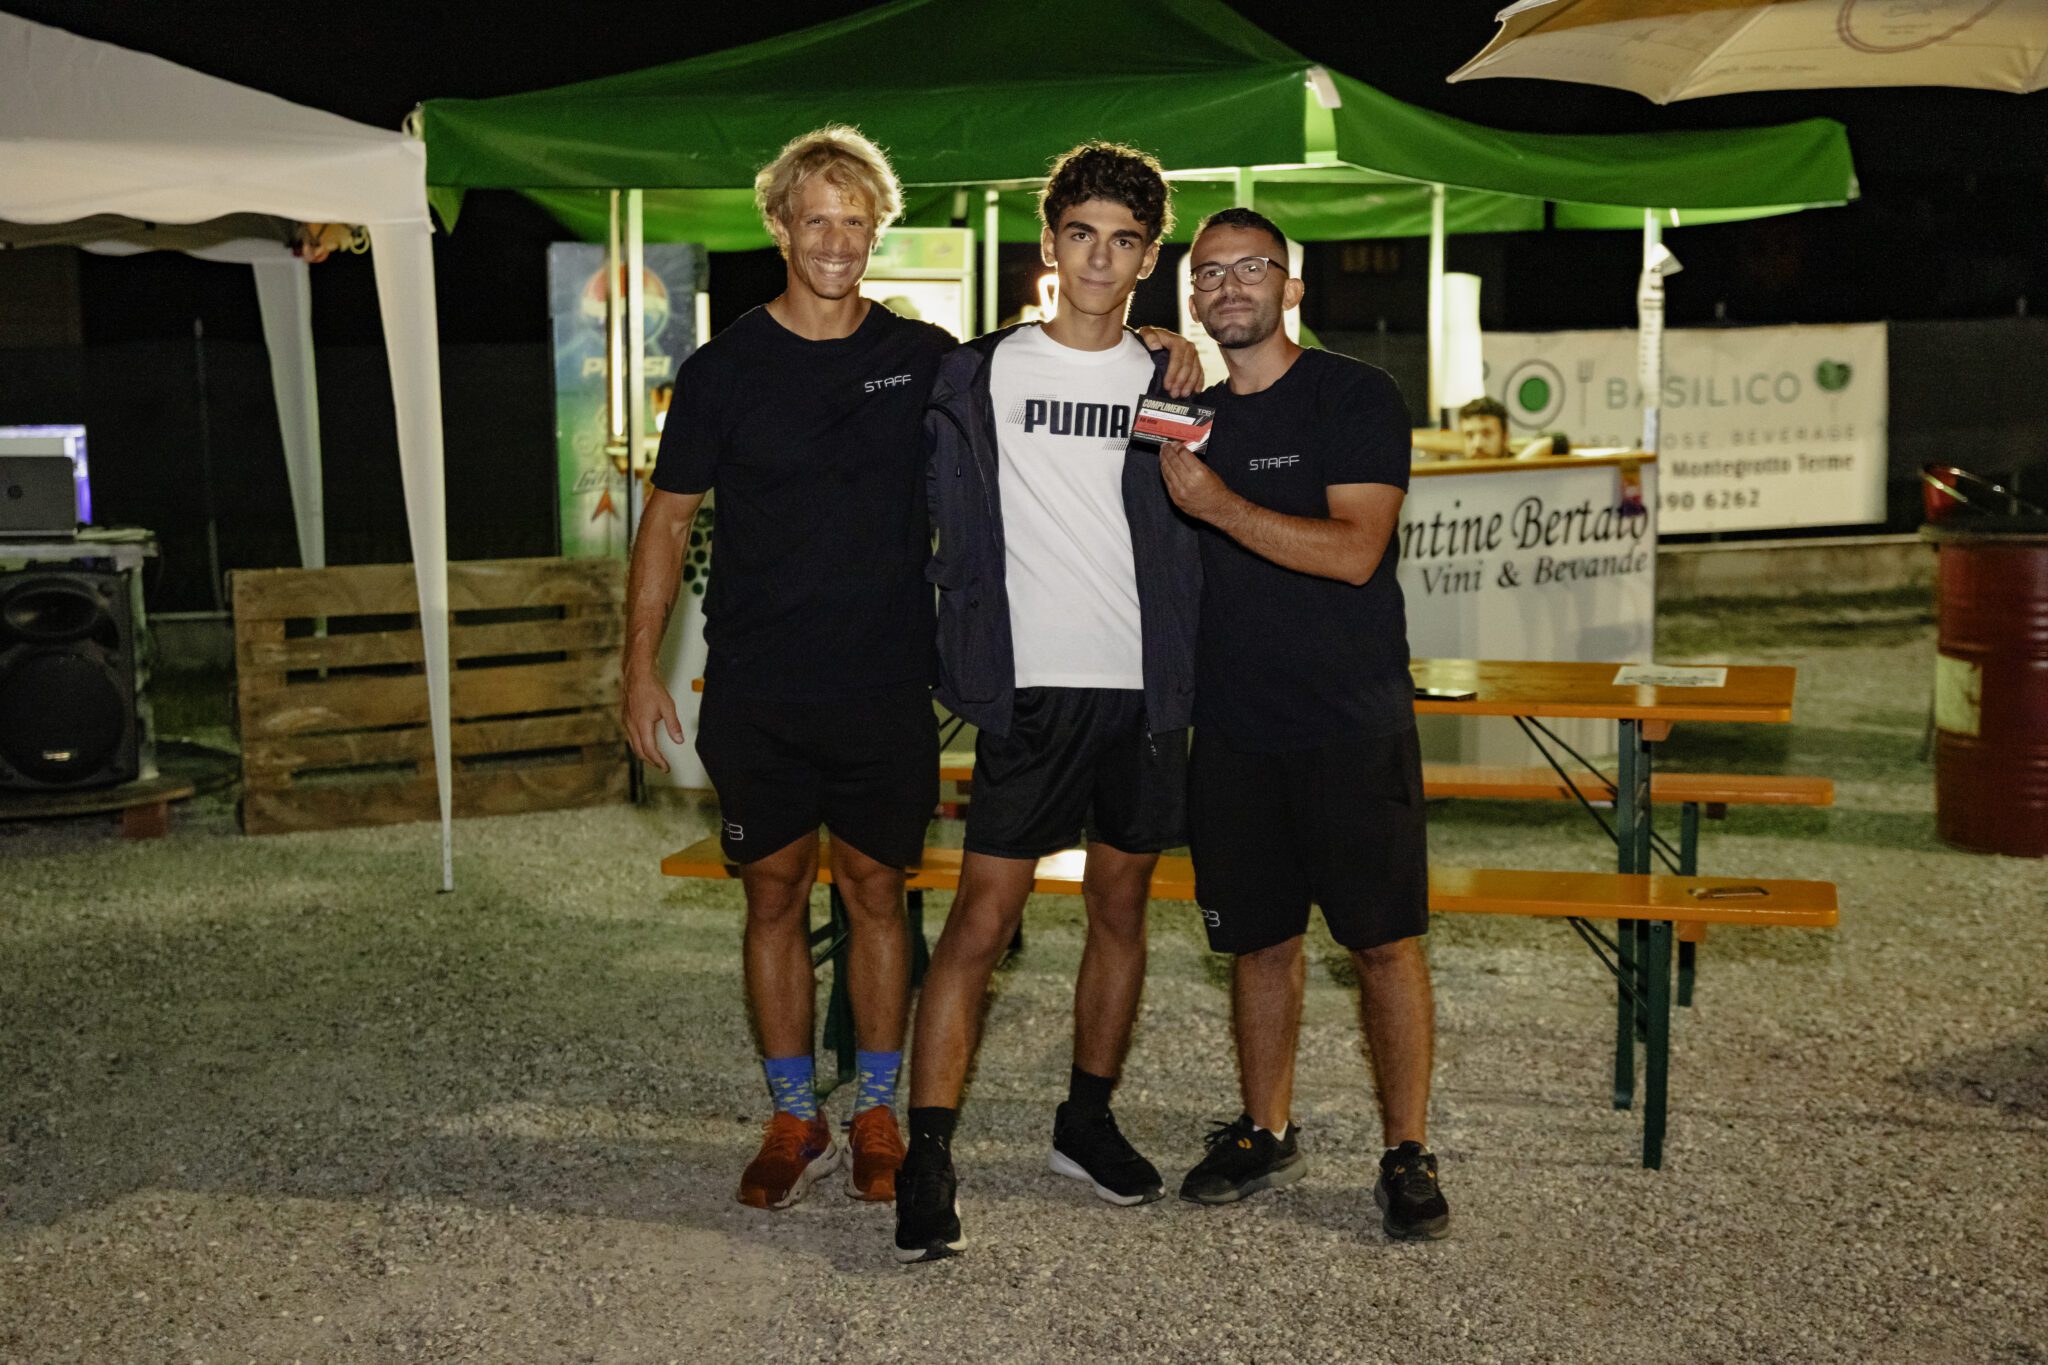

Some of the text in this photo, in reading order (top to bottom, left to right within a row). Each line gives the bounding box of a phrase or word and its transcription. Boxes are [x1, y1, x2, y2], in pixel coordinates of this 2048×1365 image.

[582, 356, 671, 377] PSI
[864, 374, 912, 392] STAFF
[1606, 372, 1801, 410] BSILICO
[1024, 399, 1130, 438] PUMA
[1249, 454, 1300, 470] STAFF
[1797, 453, 1854, 472] Terme
[1703, 487, 1761, 511] 6262
[1402, 499, 1504, 560] ntine
[1421, 543, 1648, 596] Vini & Bevande
